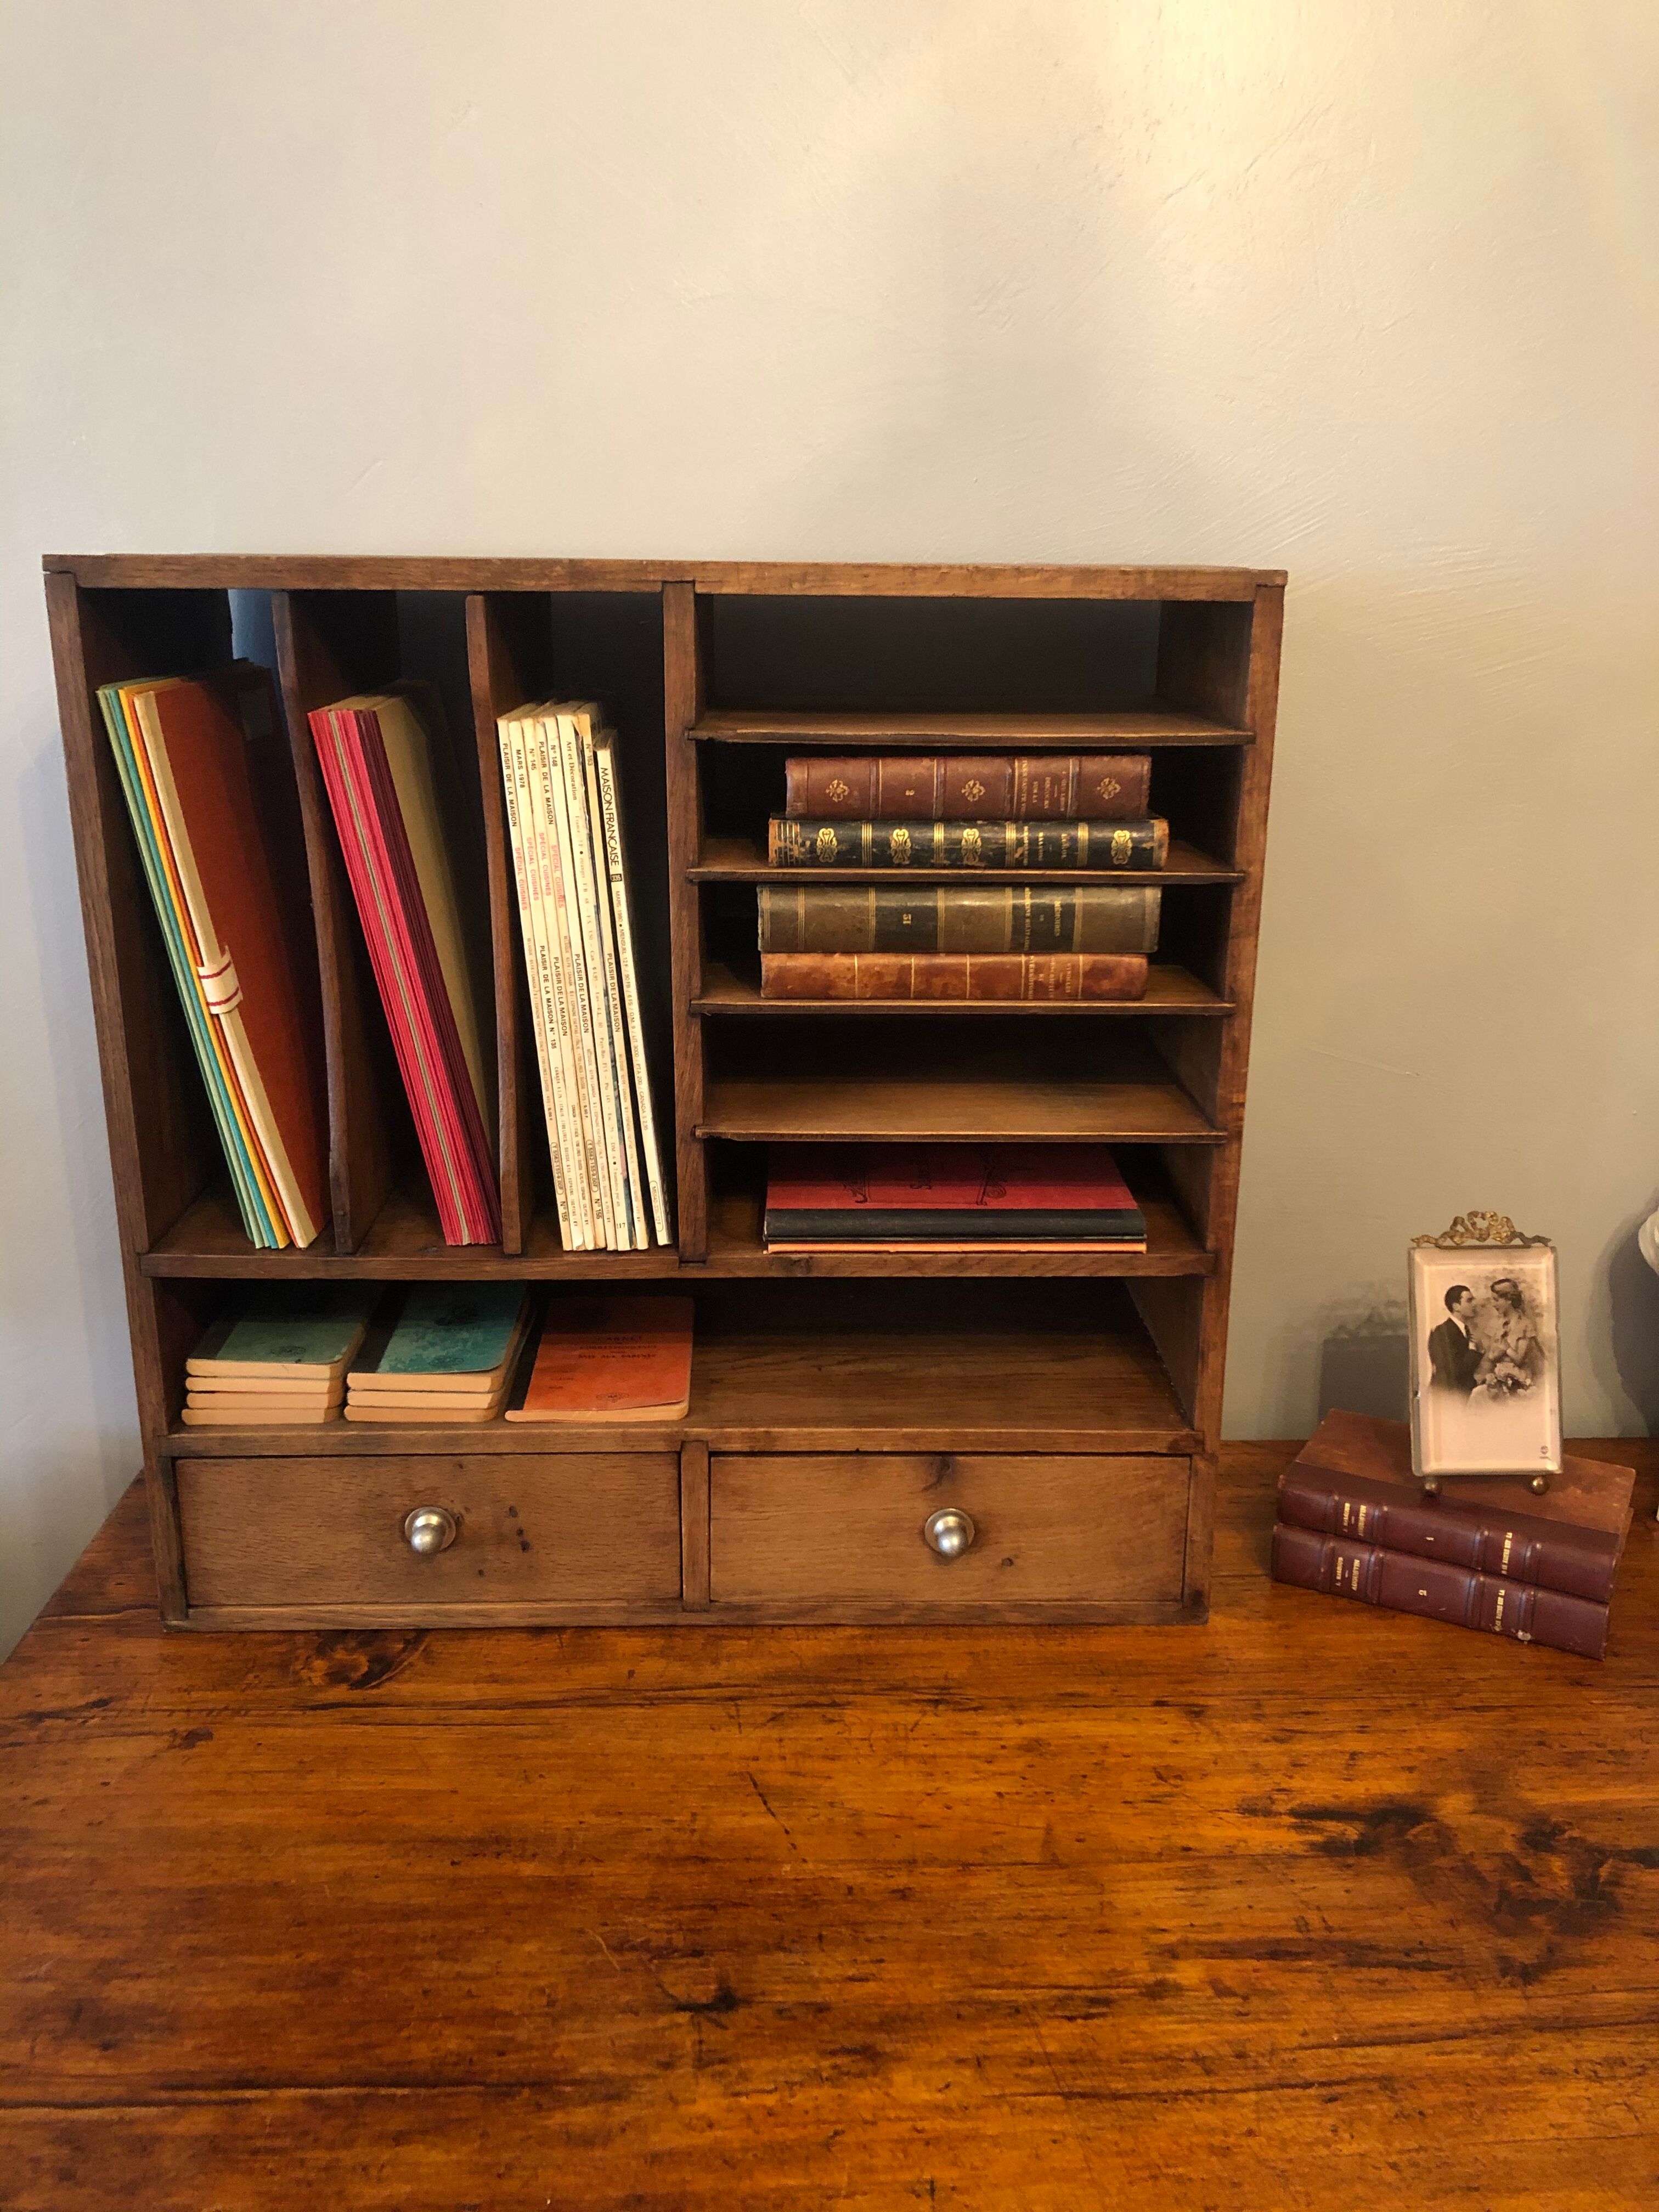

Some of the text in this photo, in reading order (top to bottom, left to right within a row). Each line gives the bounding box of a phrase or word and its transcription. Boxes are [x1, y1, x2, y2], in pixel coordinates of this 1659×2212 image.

[506, 774, 512, 782] DE
[543, 772, 548, 781] DE
[544, 785, 550, 793] LA
[569, 762, 578, 800] Décoration
[600, 766, 612, 810] MAISON
[508, 787, 514, 795] LA
[509, 799, 517, 826] MAISON
[545, 797, 554, 825] MAISON
[530, 869, 538, 900] CUISINES
[542, 865, 551, 896] CUISINES
[555, 877, 563, 908] CUISINES
[518, 879, 527, 910] CUISINES
[543, 974, 548, 983] DE
[578, 983, 584, 992] DE
[610, 982, 616, 991] DE
[553, 957, 567, 1036] PLAISIR DE LA MAISON
[579, 994, 585, 1002] LA
[611, 993, 617, 1002] LA
[580, 1004, 589, 1033] MAISON
